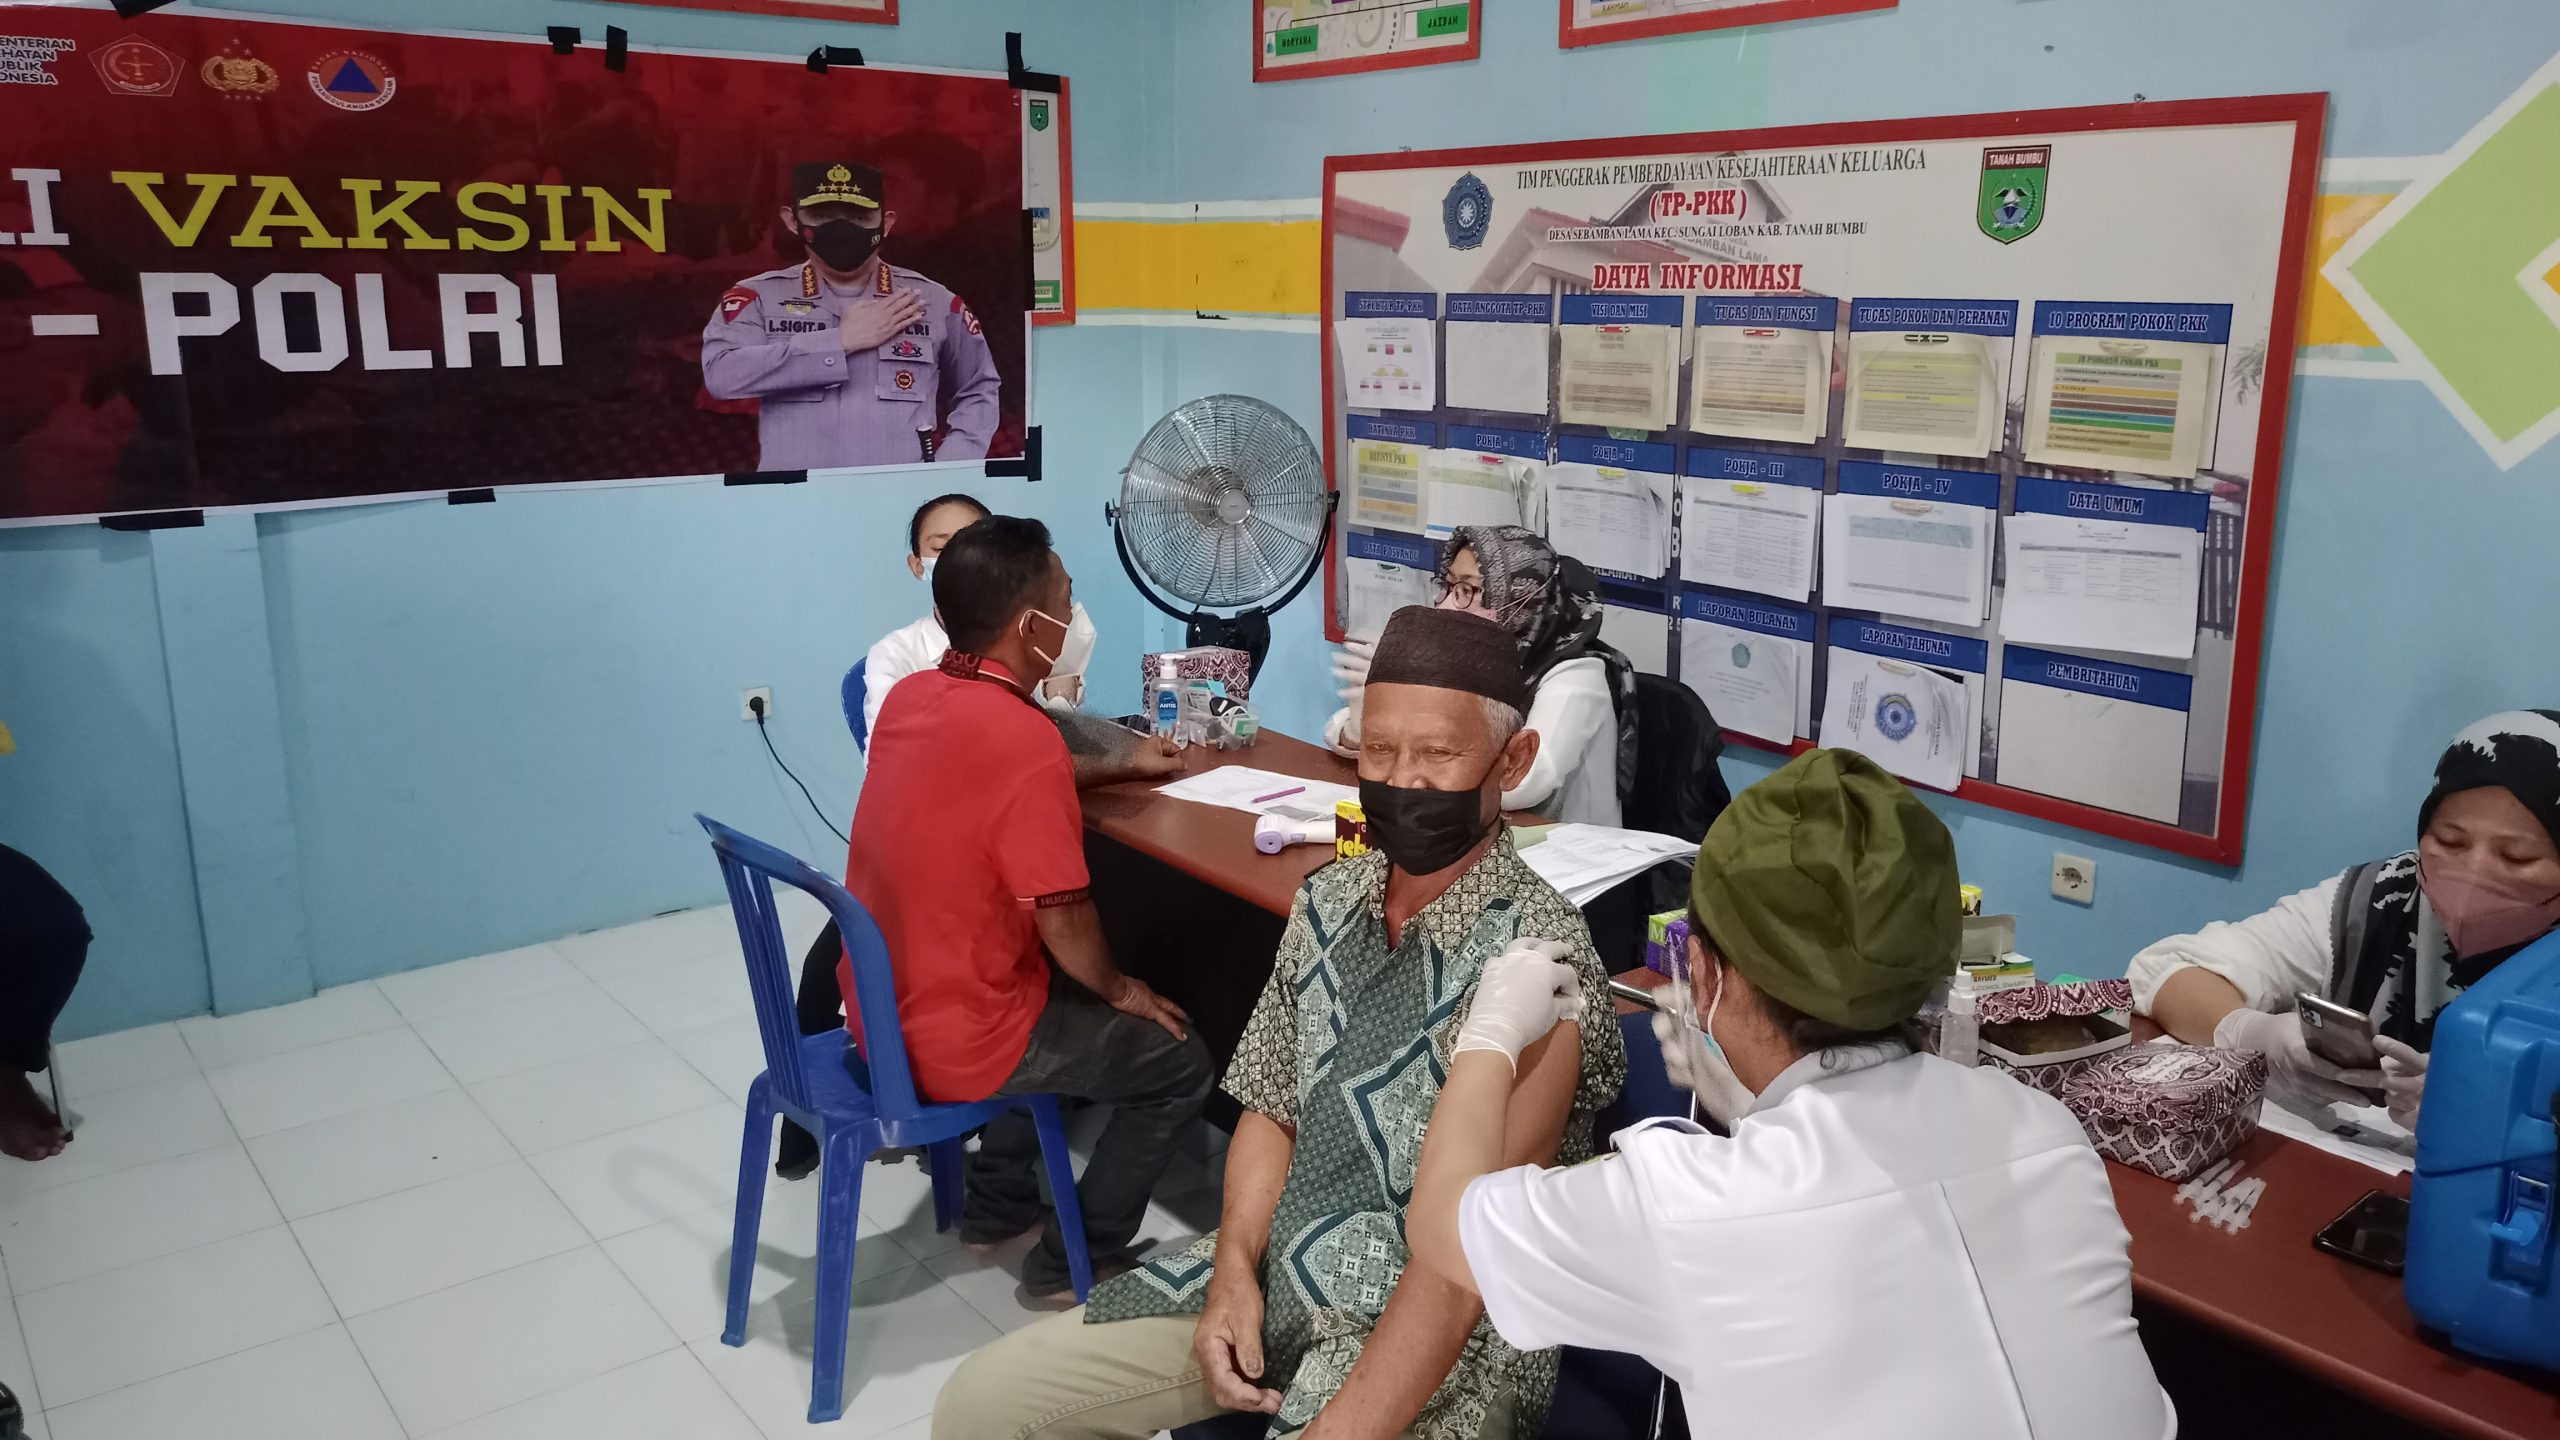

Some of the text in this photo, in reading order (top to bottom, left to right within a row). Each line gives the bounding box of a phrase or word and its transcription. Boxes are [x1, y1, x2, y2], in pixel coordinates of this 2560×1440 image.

[1517, 148, 1926, 189] TIM PENGGERAK PEMBERDAYAAN KESEJAHTERAAN KELUARGA
[1989, 152, 2044, 166] TANAH BUMBU
[111, 171, 672, 253] VAKSIN
[1550, 222, 1868, 241] DESA SEBAMBAN LAMA KEC. SUNGAI LOBAN KAB. TANAH BUMBU
[1592, 263, 1804, 291] DATA INFORMASI
[1452, 301, 1546, 316] DATA ANGGOTA TP-PKK
[1591, 303, 1648, 318] VISI DAN MISI
[1714, 305, 1817, 322] TUGAS DAN FUNGSI
[1859, 307, 2010, 327] TUGAS POKOK DAN PERANAN
[140, 272, 563, 376] POLRI
[2049, 311, 2208, 333] 10 PROGRAM POKOK PKK
[1476, 433, 1502, 450] POKJA
[1593, 445, 1618, 463] POKJA
[1724, 458, 1758, 477] POKJA
[1768, 462, 1785, 478] III
[1882, 473, 1921, 494] POKJA
[1934, 479, 1951, 494] IV
[2068, 491, 2145, 516] DATA UMUM
[1697, 600, 1798, 632] LAPORAN BULANAN
[1861, 626, 1952, 657] LAPORAN TAHUNAN
[2047, 661, 2140, 692] PEMBRITAHUAN
